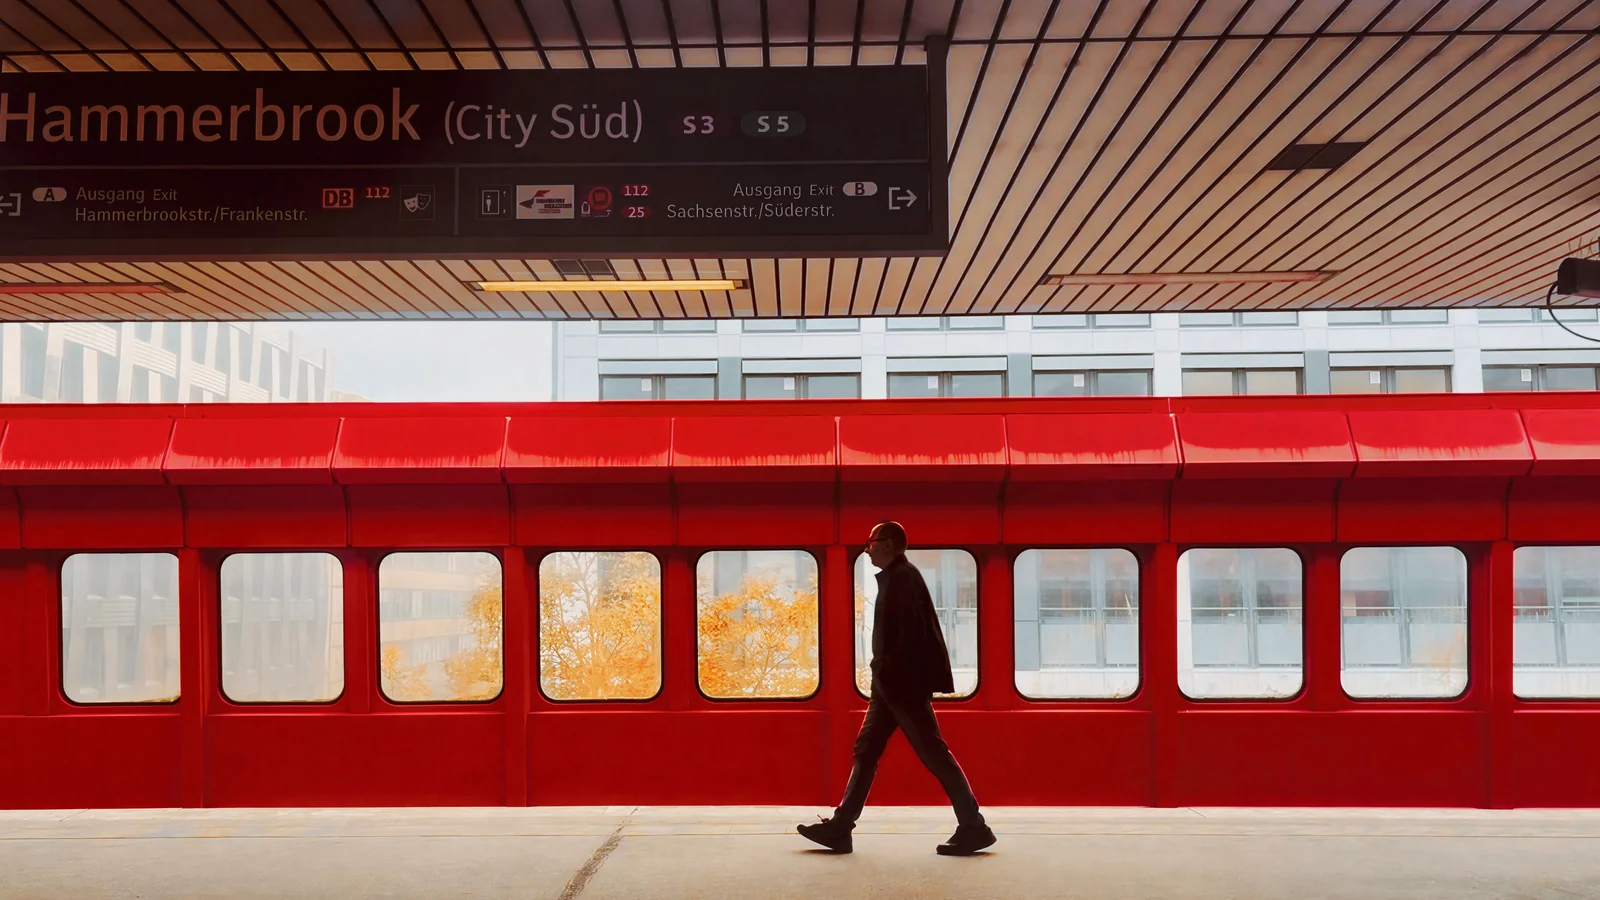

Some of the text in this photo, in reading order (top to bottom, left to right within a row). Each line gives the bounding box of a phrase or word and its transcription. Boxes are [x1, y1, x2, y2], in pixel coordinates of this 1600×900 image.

[0, 87, 643, 150] Hammerbrook (City Süd)
[43, 187, 56, 201] A
[76, 186, 178, 204] Ausgang Exit
[324, 189, 352, 207] DB
[366, 186, 390, 199] 112
[624, 185, 649, 197] 112
[733, 182, 834, 200] Ausgang Exit
[854, 182, 866, 196] B
[75, 206, 308, 224] Hammerbrookstr./Frankenstr.
[629, 206, 645, 218] 25
[667, 202, 836, 220] Sachsenstr./Süderstr.
